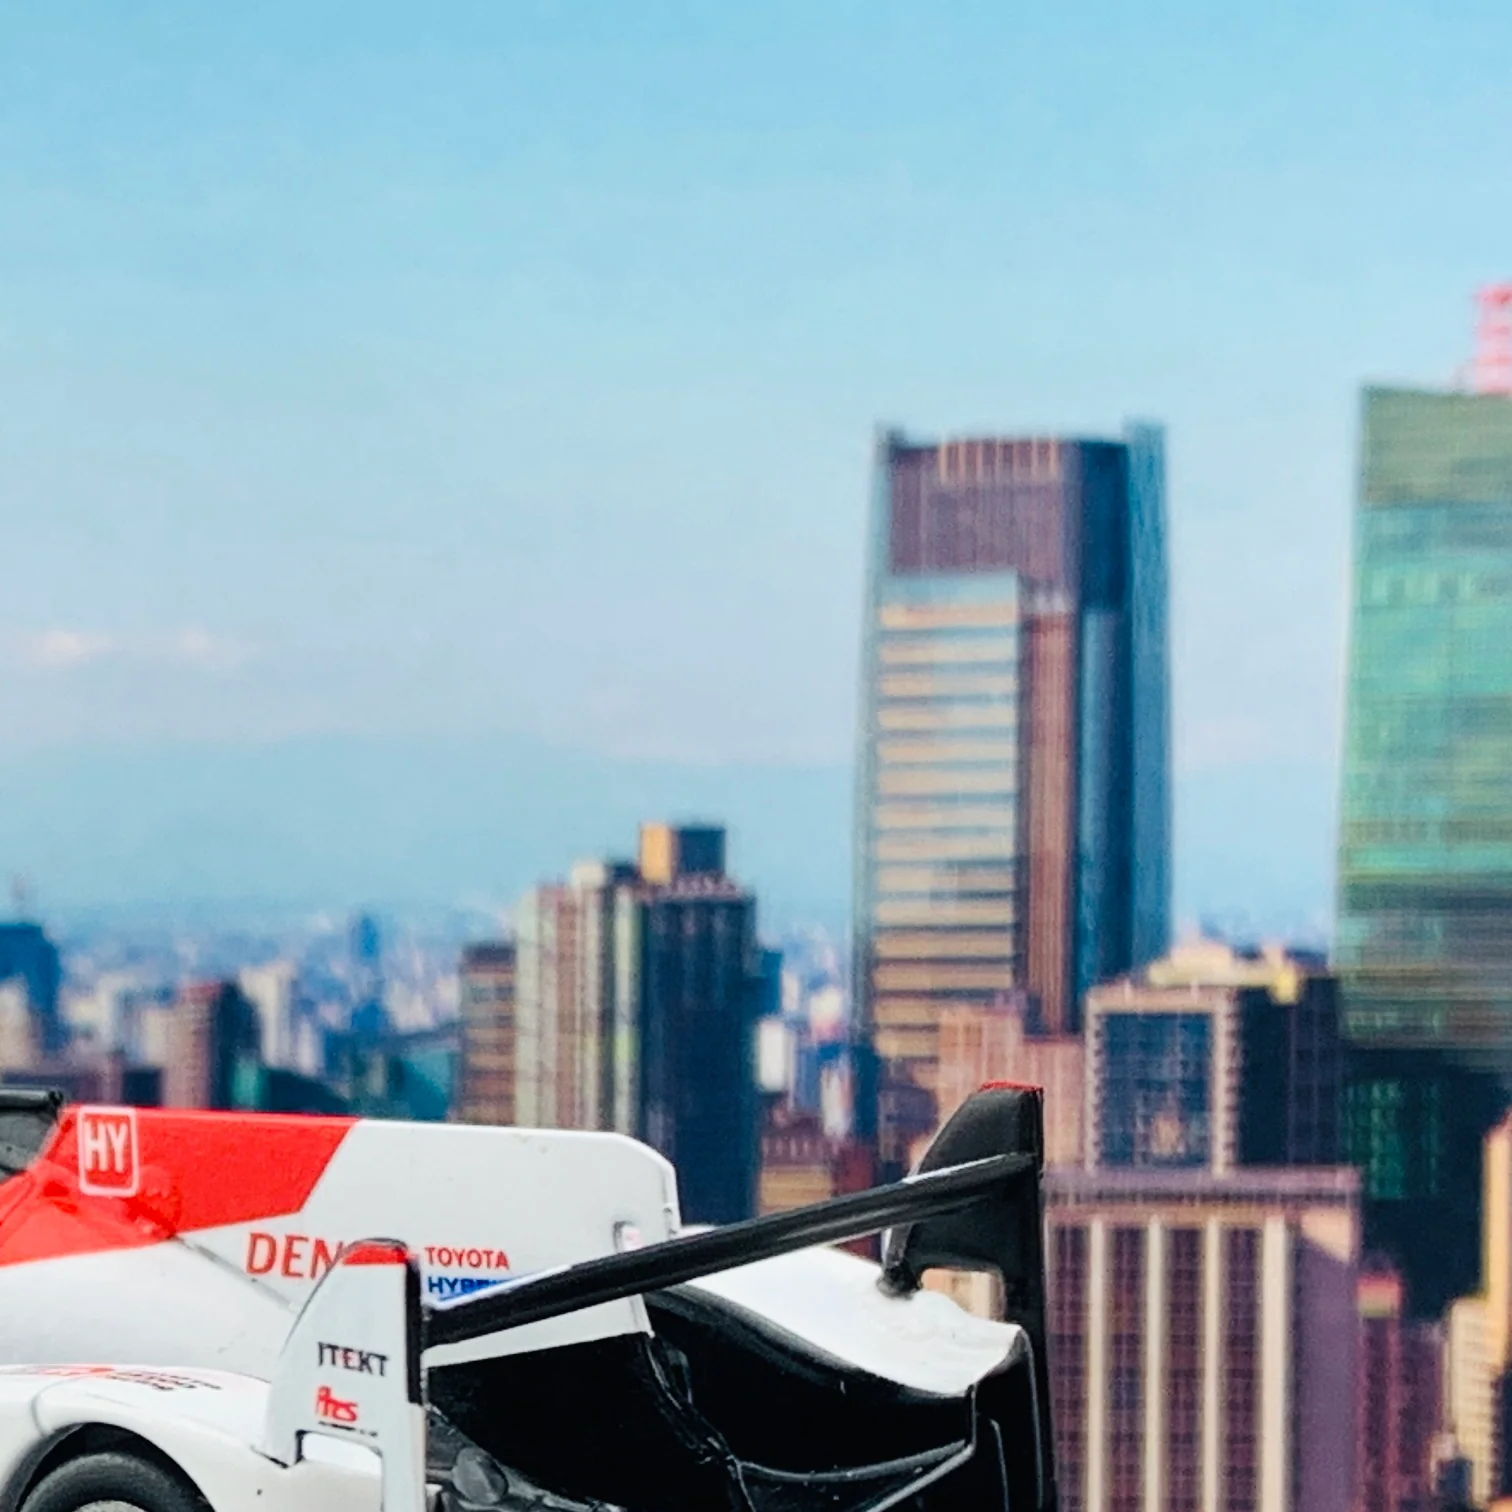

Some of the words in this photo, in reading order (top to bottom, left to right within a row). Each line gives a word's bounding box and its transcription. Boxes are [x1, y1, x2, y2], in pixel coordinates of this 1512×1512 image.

[83, 1120, 128, 1174] HY
[246, 1231, 344, 1280] DEN
[424, 1246, 511, 1270] TOYOTA
[318, 1341, 389, 1377] JTEKT
